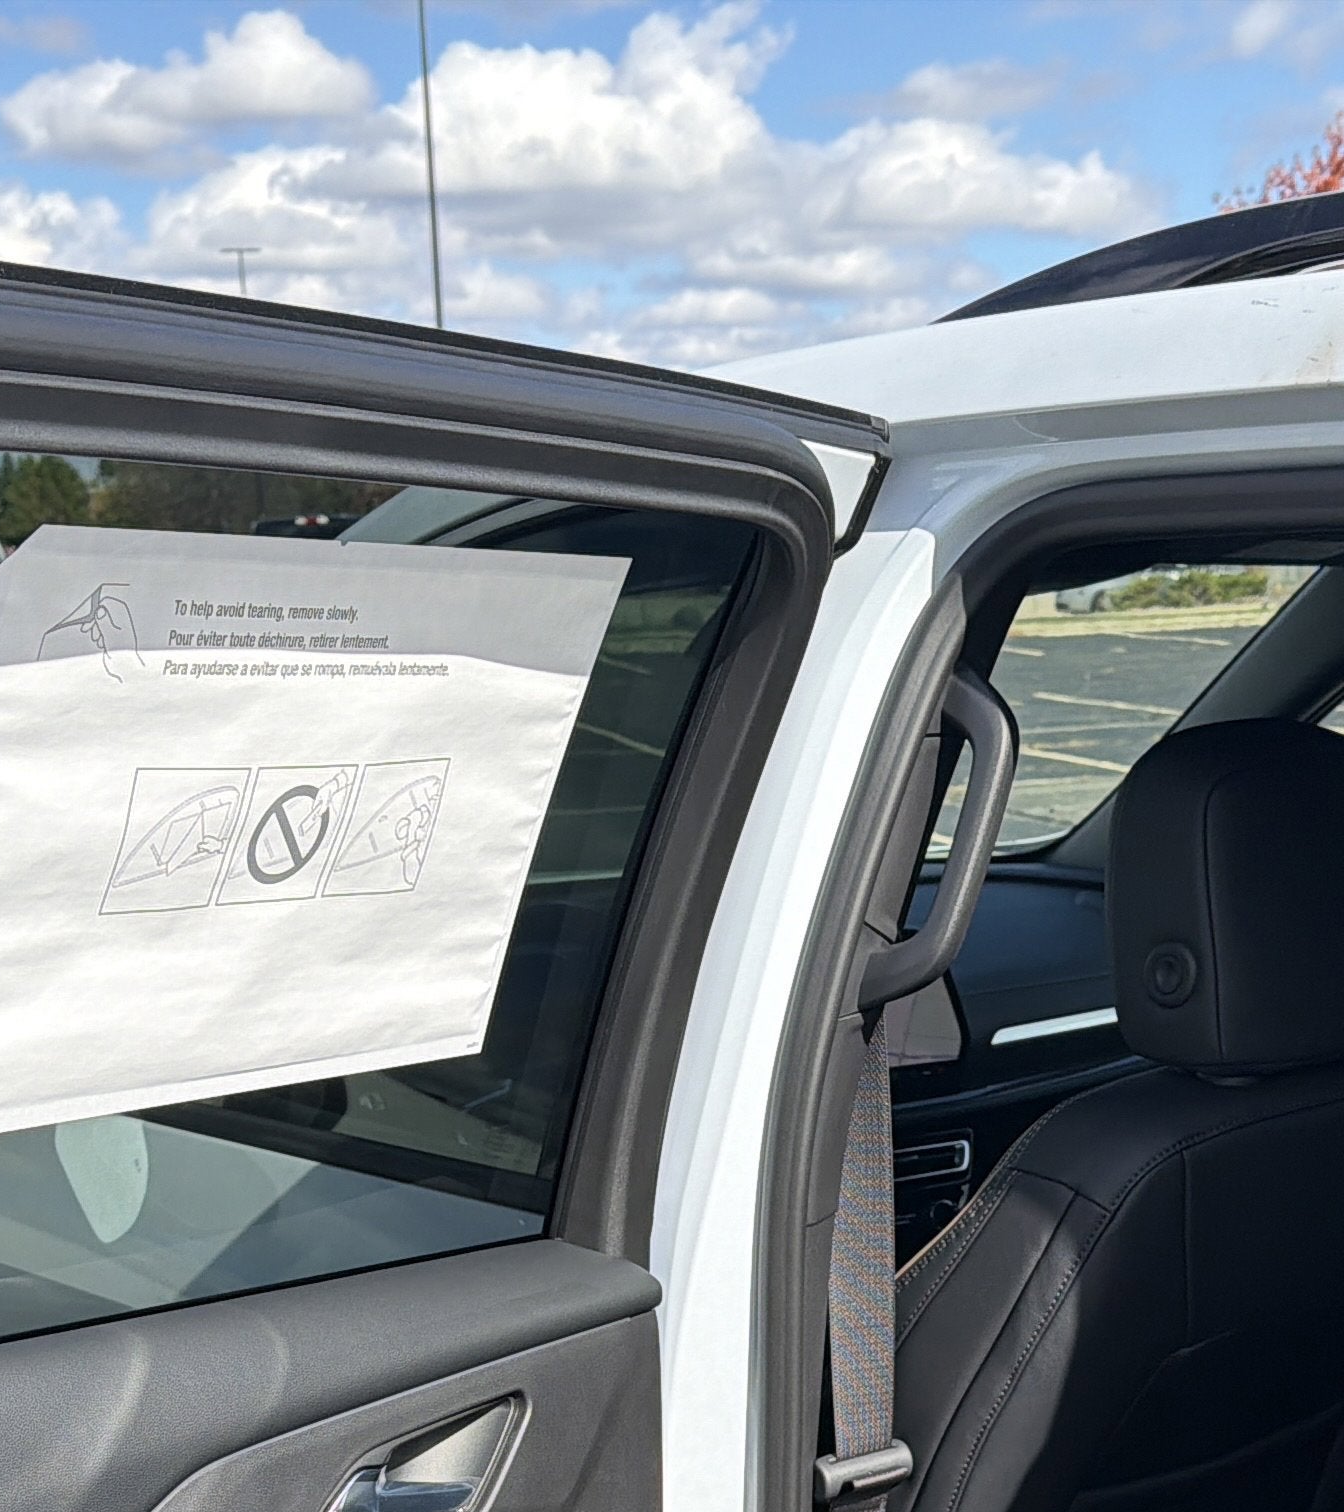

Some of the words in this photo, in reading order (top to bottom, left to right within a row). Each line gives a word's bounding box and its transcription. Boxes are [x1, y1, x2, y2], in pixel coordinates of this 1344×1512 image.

[174, 599, 188, 616] To
[189, 600, 214, 620] help
[216, 601, 246, 618] avoid
[247, 602, 285, 622] tearing,
[287, 606, 324, 620] remove
[325, 605, 359, 624] slowly.
[168, 629, 194, 646] Pour
[196, 629, 228, 647] éviter
[229, 631, 256, 648] toute
[257, 631, 306, 650] déchirure,
[308, 633, 340, 649] retirer
[340, 634, 390, 649] lentement.
[162, 659, 188, 676] Para
[189, 660, 239, 679] ayudarse
[239, 663, 248, 676] a
[249, 661, 278, 677] evitar
[280, 663, 299, 679] que
[300, 663, 313, 676] se
[314, 663, 346, 679] rompa,
